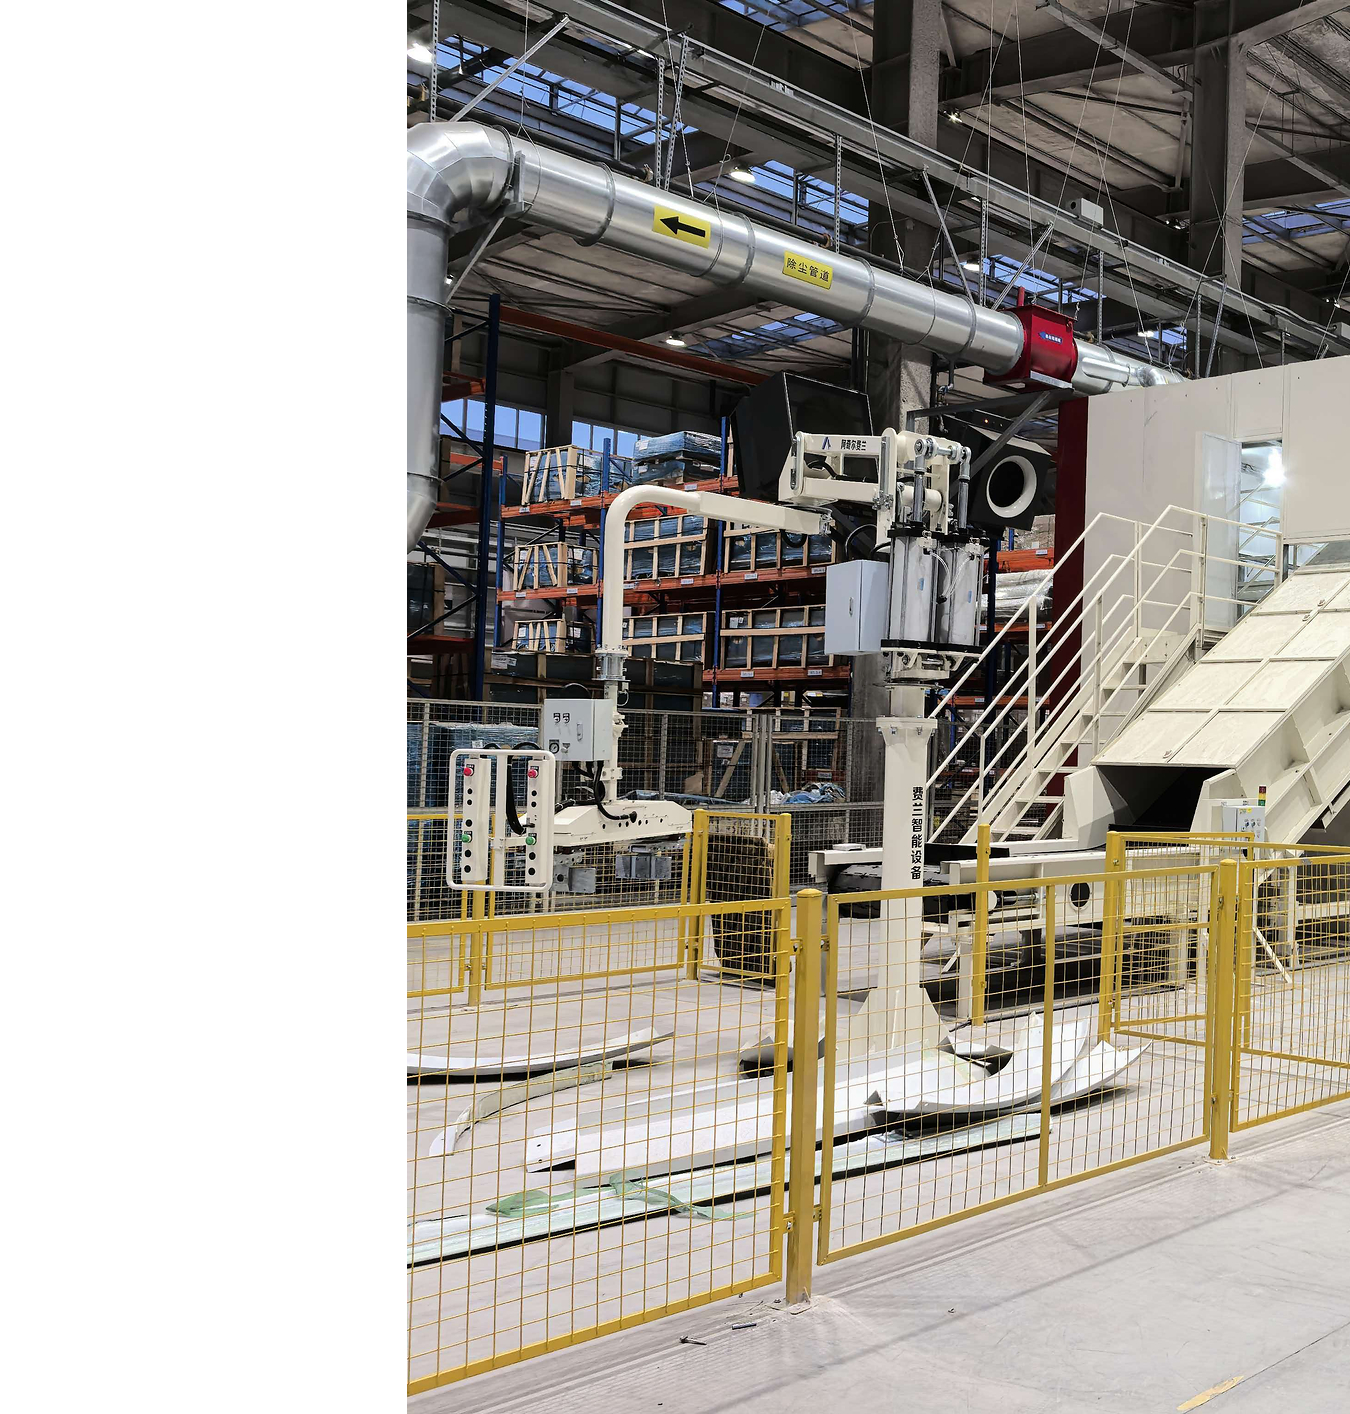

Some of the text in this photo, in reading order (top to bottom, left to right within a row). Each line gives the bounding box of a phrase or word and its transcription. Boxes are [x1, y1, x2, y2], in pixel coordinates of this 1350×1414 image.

[786, 257, 830, 282] 除尘管道
[910, 786, 924, 880] 费兰智能设备
